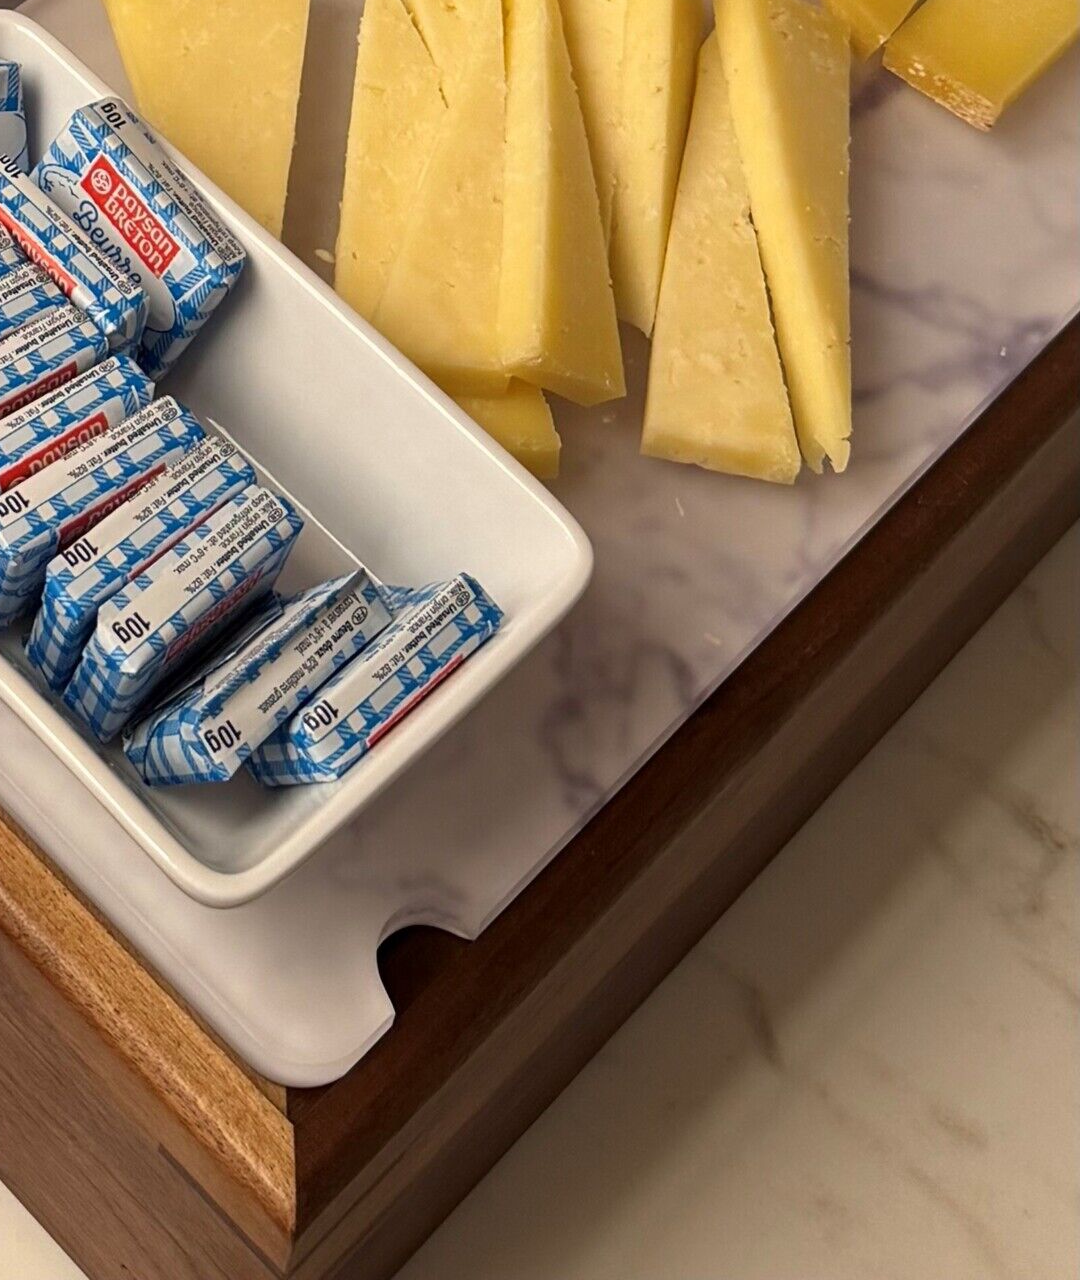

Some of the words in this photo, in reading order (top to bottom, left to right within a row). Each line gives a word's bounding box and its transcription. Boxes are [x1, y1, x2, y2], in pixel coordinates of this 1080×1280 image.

[100, 102, 127, 130] 10g
[111, 183, 173, 257] paysan
[71, 231, 92, 254] butter.
[71, 200, 143, 288] Beurre
[103, 197, 164, 270] BRETON
[88, 251, 120, 282] Unsalted
[1, 278, 36, 300] Unsalted
[37, 318, 73, 343] Unsalted
[11, 337, 39, 356] butter.
[64, 369, 99, 394] Unsalted
[37, 390, 65, 408] butter.
[126, 417, 162, 443] Unsalted
[100, 438, 128, 457] butter.
[86, 454, 103, 468] Fat:
[187, 453, 221, 482] Unsalted
[163, 477, 190, 498] butter.
[250, 490, 269, 508] Keep
[150, 496, 167, 510] Fat:
[258, 498, 277, 514] Milk:
[215, 504, 254, 540] refrigerated
[241, 512, 261, 531] origin
[218, 527, 244, 549] France.
[236, 519, 269, 550] Unsalted
[59, 532, 99, 568] 10g
[213, 545, 239, 568] butter.
[172, 558, 192, 575] max.
[200, 565, 217, 580] Fat:
[183, 576, 204, 594] 82%.
[429, 595, 450, 615] origin
[111, 611, 151, 644] 10g
[406, 611, 433, 634] France.
[424, 603, 458, 635] Unsalted
[330, 620, 354, 643] Beurre
[401, 630, 428, 654] butter.
[388, 651, 406, 667] Fat:
[302, 699, 339, 732] 10g
[203, 719, 242, 754] 10g
